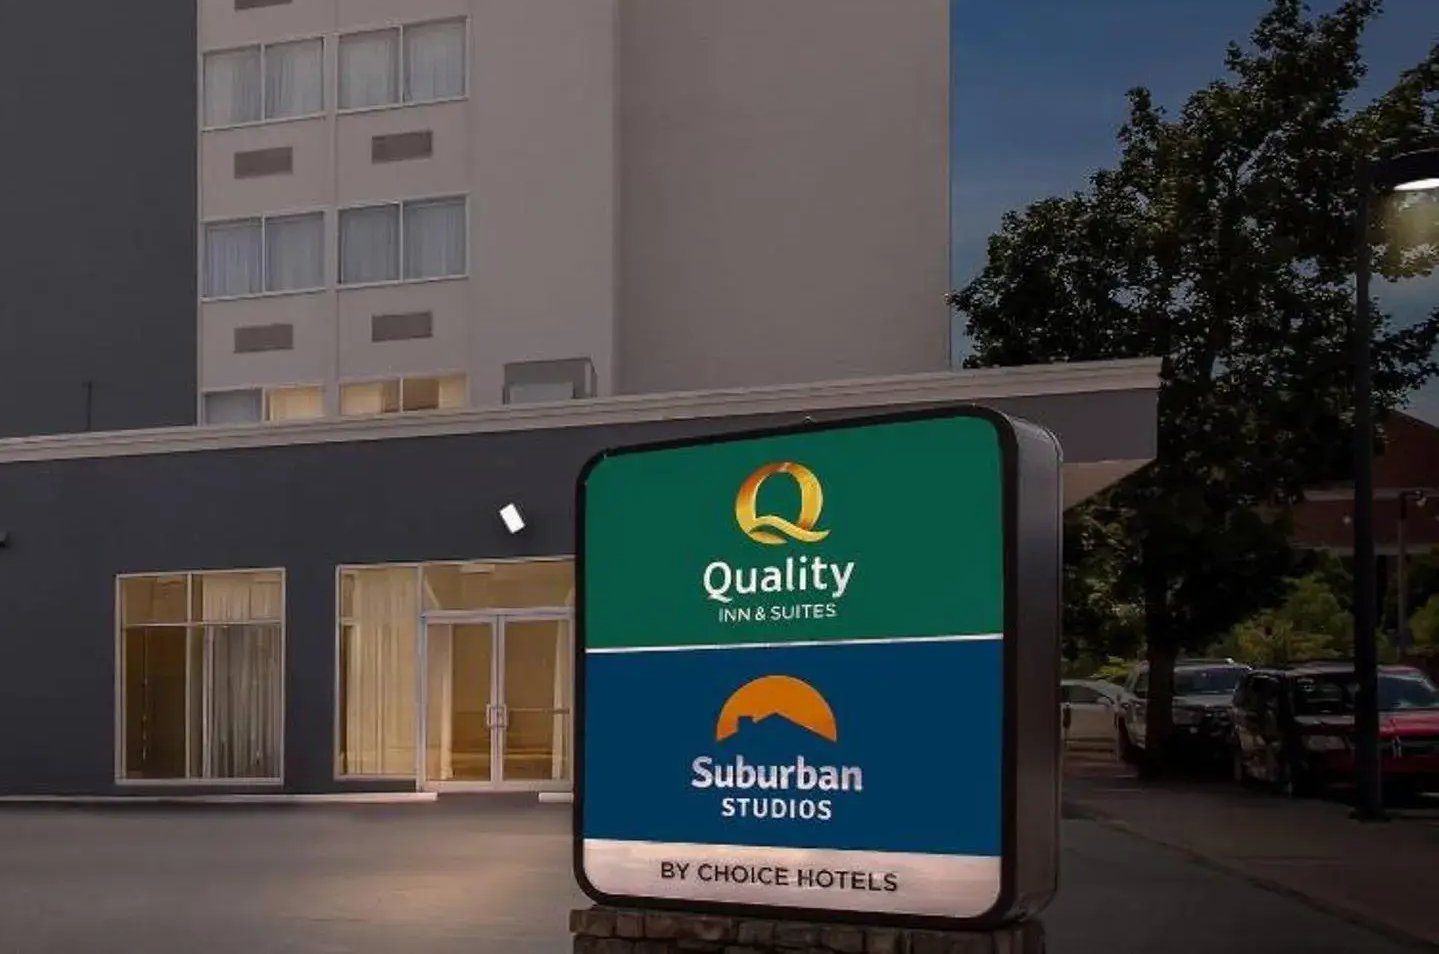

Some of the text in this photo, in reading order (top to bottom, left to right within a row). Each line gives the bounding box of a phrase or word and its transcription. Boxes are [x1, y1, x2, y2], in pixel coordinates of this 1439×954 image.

[735, 461, 831, 545] Q
[703, 556, 855, 603] Quality
[718, 602, 837, 622] INN & SUITES
[691, 755, 863, 791] Suburban
[721, 797, 832, 820] STUDIOS
[660, 861, 898, 893] BY CHOICE HOTELS
